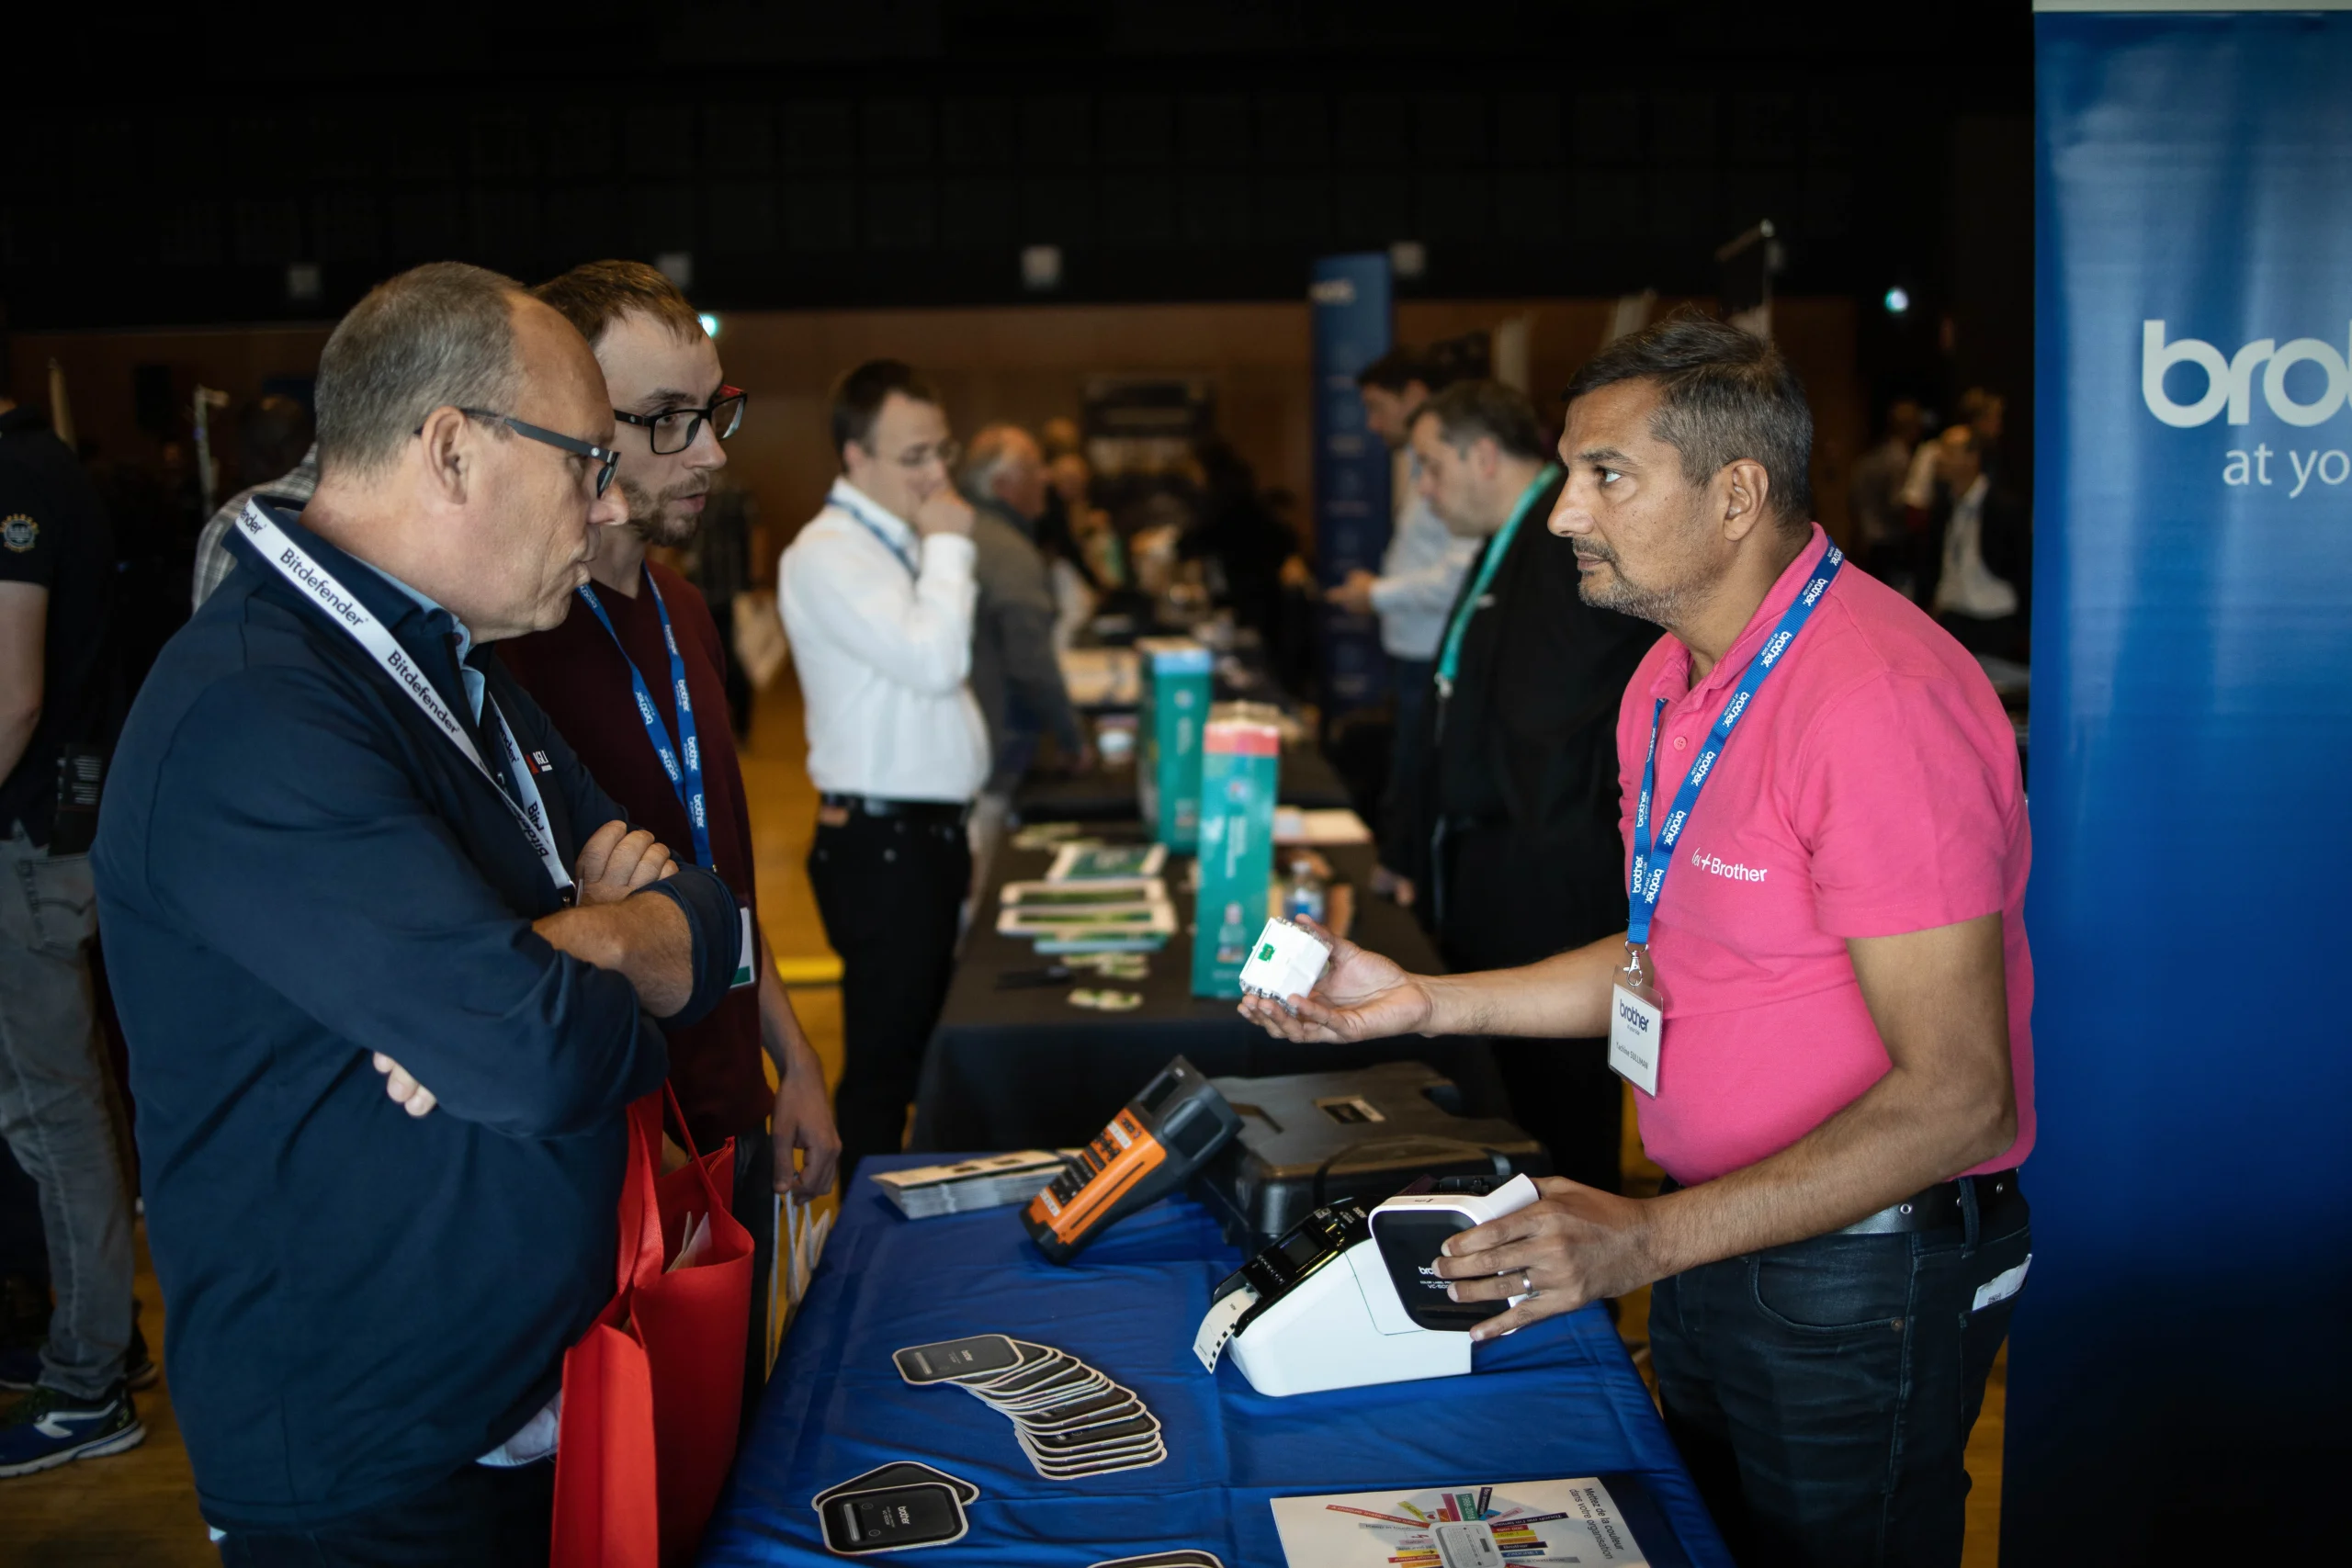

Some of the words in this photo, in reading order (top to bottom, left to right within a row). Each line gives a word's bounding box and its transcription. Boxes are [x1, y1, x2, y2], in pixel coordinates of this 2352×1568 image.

[2142, 320, 2352, 428] bro
[2222, 443, 2273, 485] at
[2289, 450, 2351, 499] yo
[279, 547, 364, 626] Bitdefender
[387, 649, 458, 733] Bitdefender
[1620, 998, 1649, 1032] brother
[1418, 1266, 1434, 1275] bro
[898, 1506, 910, 1525] brother
[1569, 1488, 1583, 1502] dans
[1577, 1502, 1591, 1518] votre
[1587, 1519, 1614, 1560] organisation
[1584, 1488, 1600, 1508] Mettez
[1596, 1508, 1606, 1517] de
[1604, 1525, 1624, 1551] couleur
